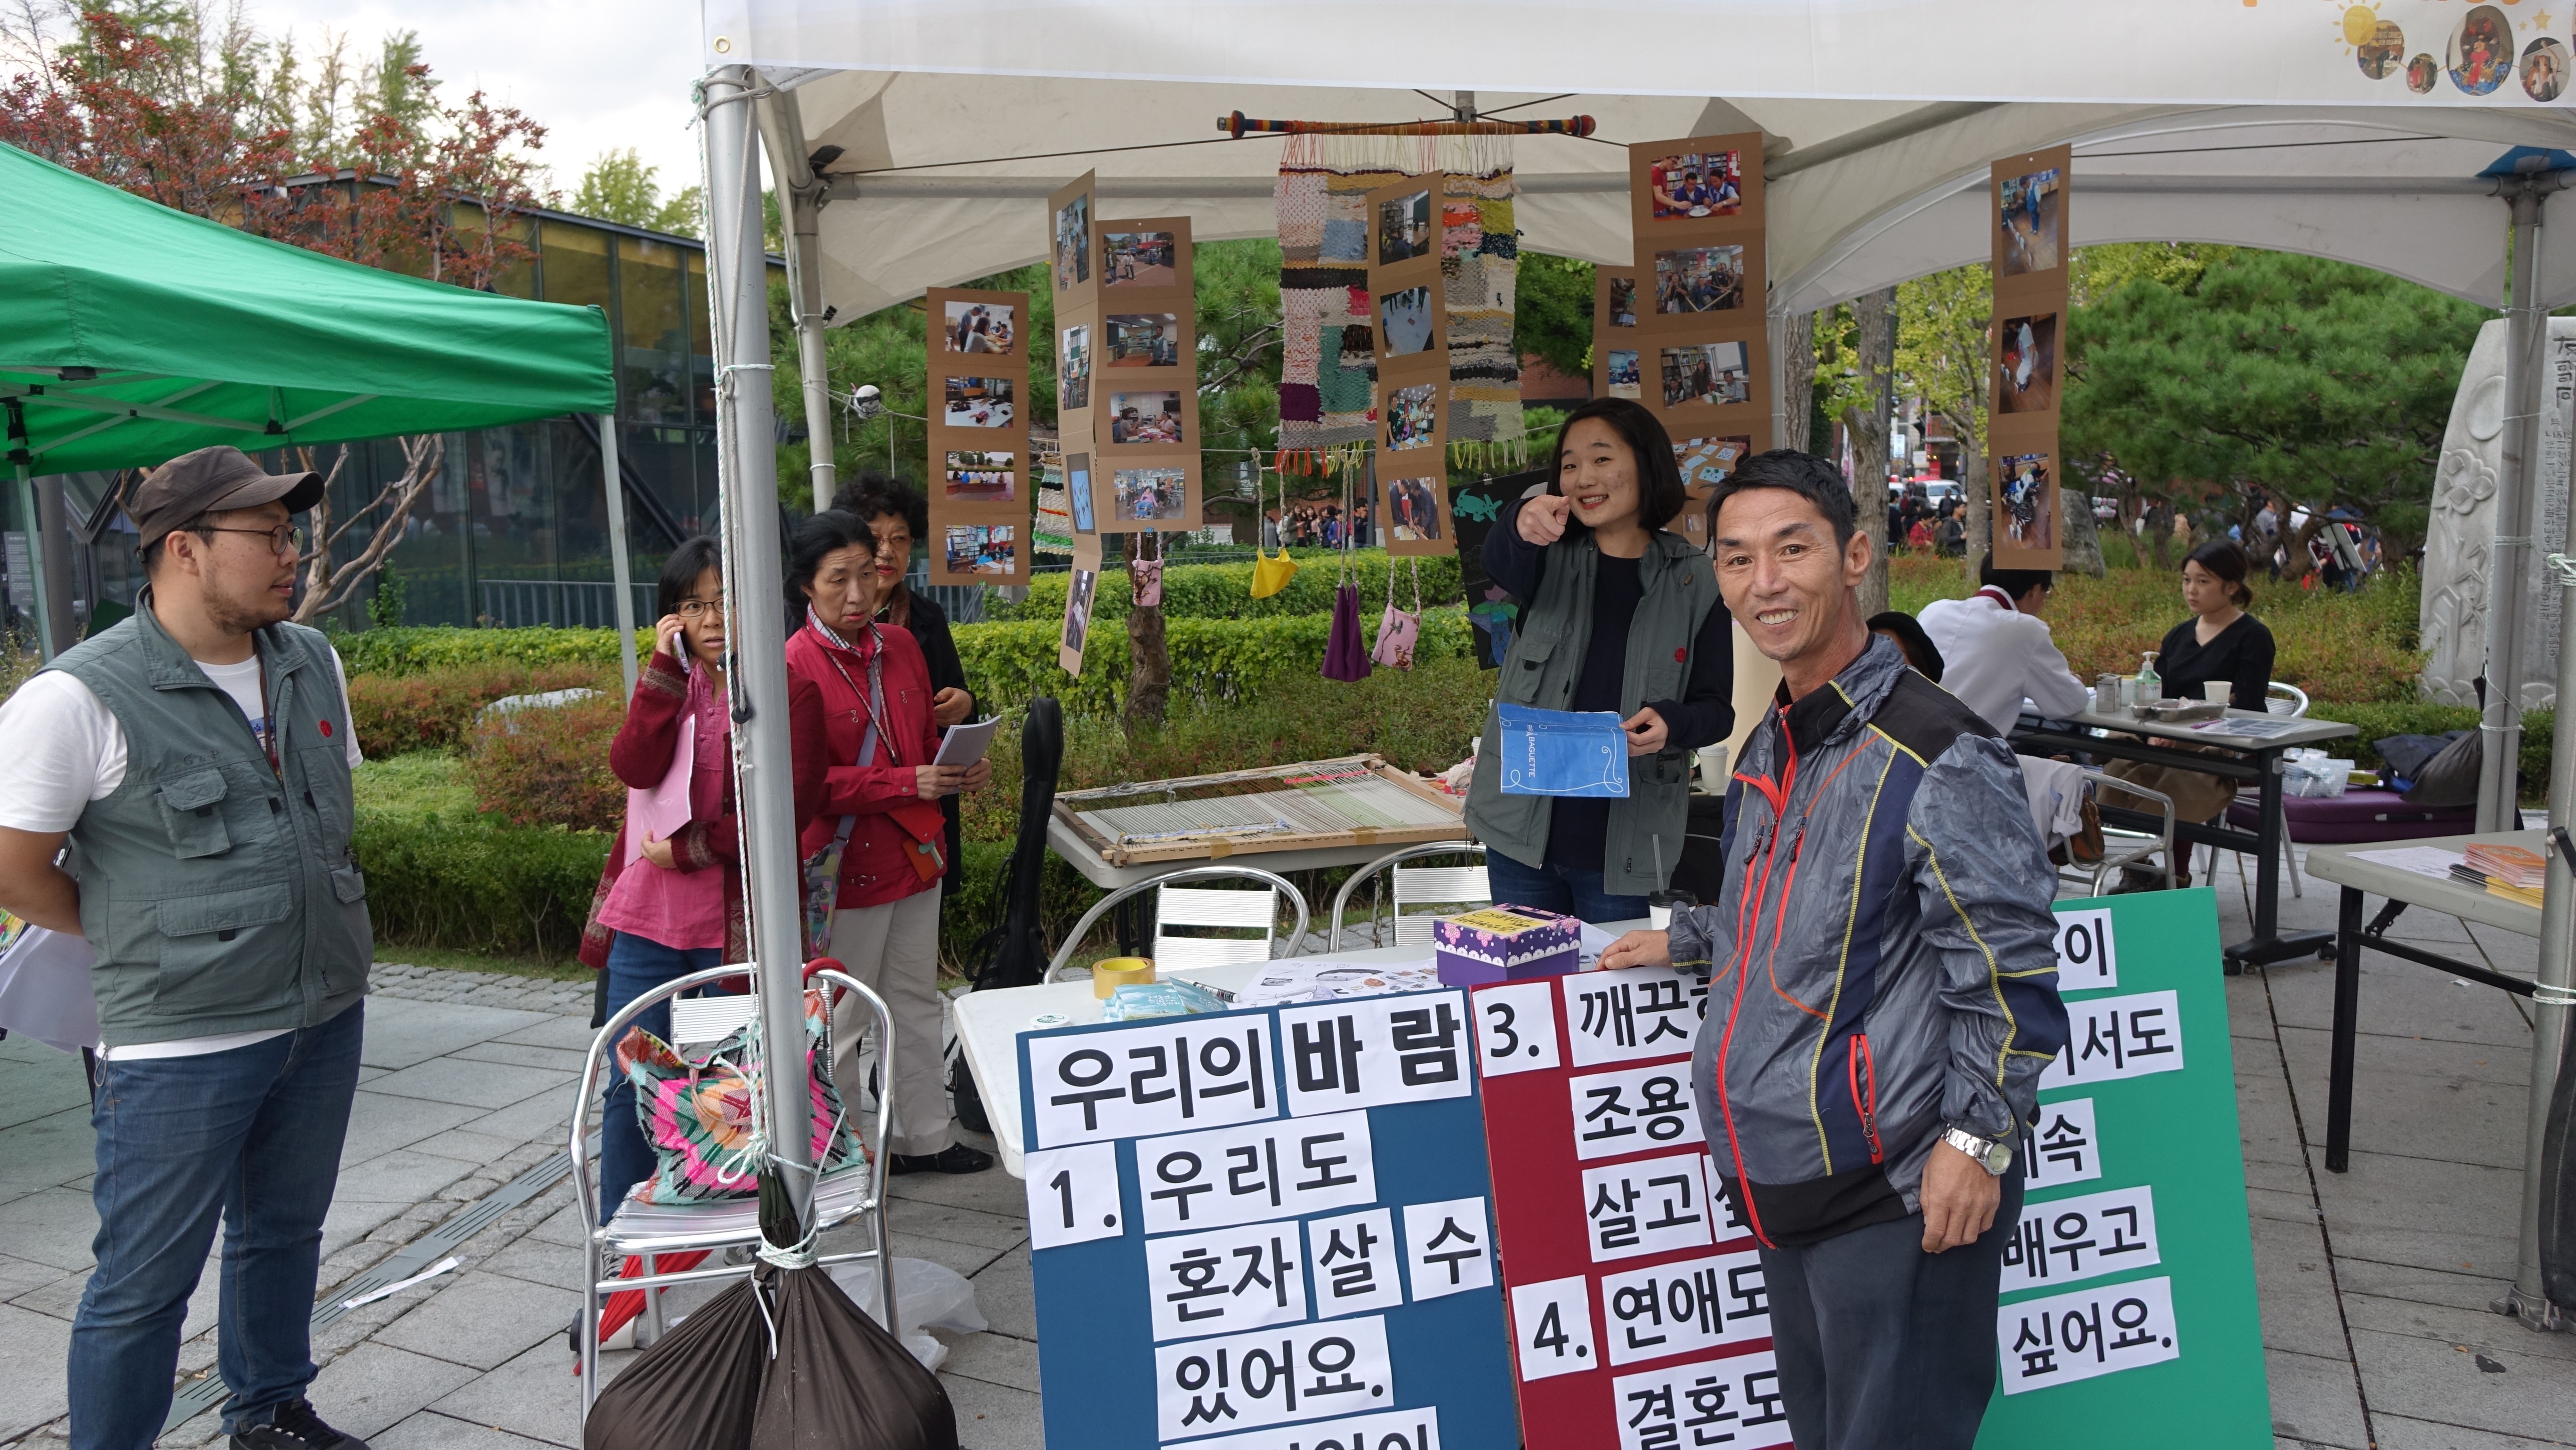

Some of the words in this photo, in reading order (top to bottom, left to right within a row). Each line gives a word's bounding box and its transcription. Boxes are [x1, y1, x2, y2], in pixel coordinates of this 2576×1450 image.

[184, 755, 193, 765] G
[210, 749, 219, 758] P
[1487, 1002, 1539, 1058] 3.
[2065, 1008, 2174, 1076] 서도
[1050, 1028, 1265, 1130] 우리의
[1583, 1076, 1694, 1141] 조용
[1050, 1170, 1117, 1228] 1.
[1151, 1132, 1357, 1220] 우리도
[1589, 1174, 1701, 1249] 살고
[1167, 1236, 1294, 1322] 혼자
[1320, 1223, 1377, 1297] 살
[1423, 1216, 1481, 1285] 수
[2002, 1205, 2146, 1277] 배우고
[1533, 1301, 1588, 1358] 4.
[1613, 1264, 1770, 1349] 연애도
[2012, 1297, 2172, 1377] 싶어요.
[1175, 1336, 1384, 1427] 있어요.
[1628, 1369, 1787, 1450] 결혼도
